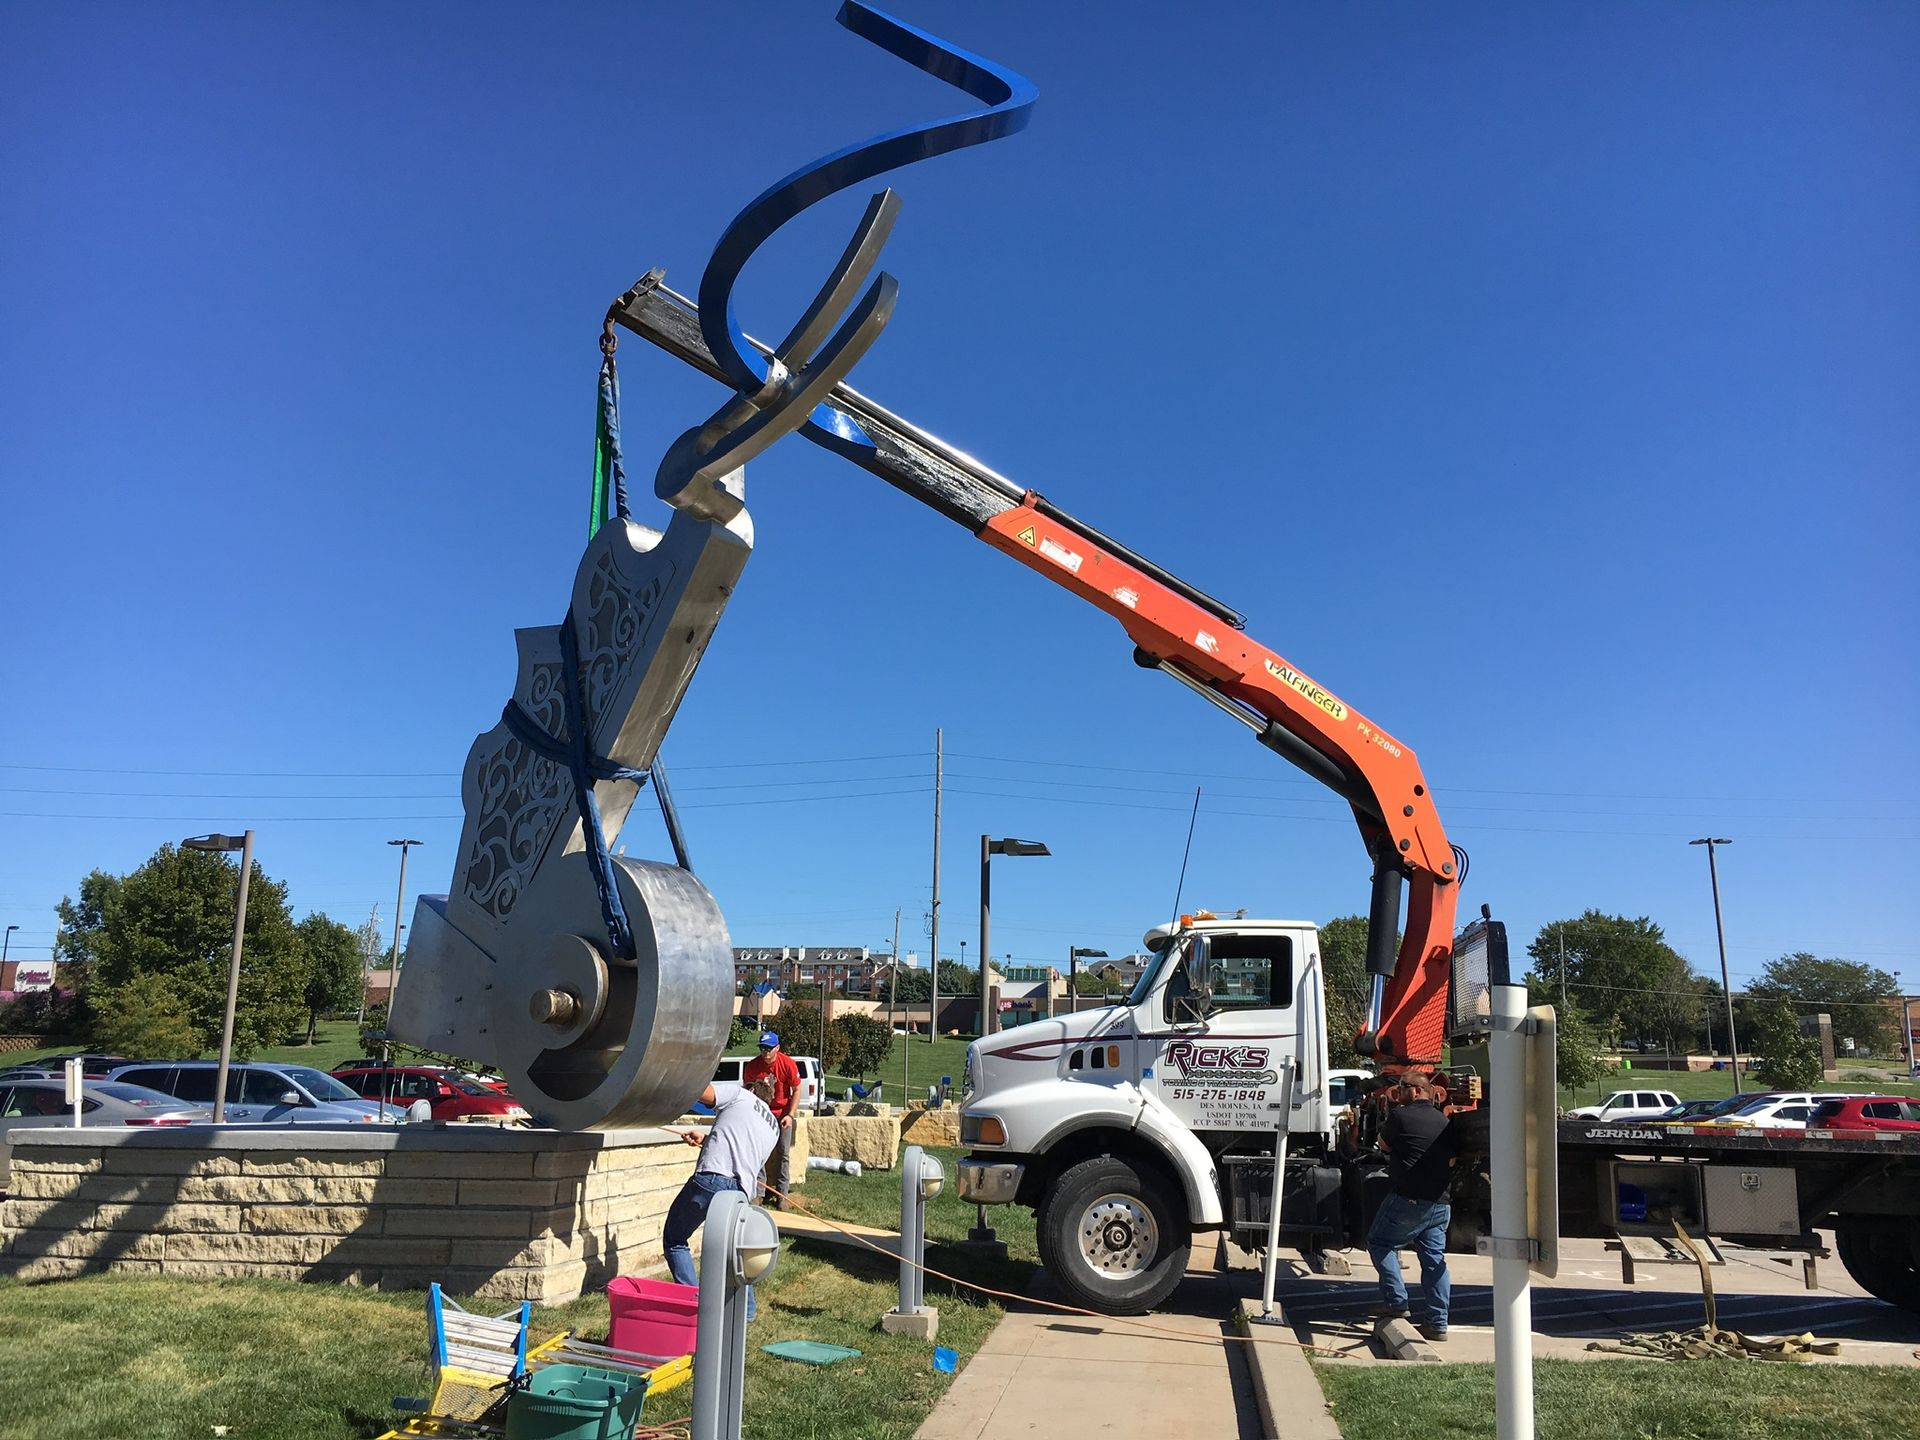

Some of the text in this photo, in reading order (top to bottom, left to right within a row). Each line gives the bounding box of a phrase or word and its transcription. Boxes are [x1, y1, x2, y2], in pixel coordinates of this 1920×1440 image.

[1269, 661, 1342, 717] PALFINGER
[1357, 722, 1402, 758] PK 32080
[1164, 1041, 1269, 1080] RICK'S
[1173, 1088, 1266, 1101] 515-276-1848
[1206, 1080, 1262, 1088] TRANSPORT
